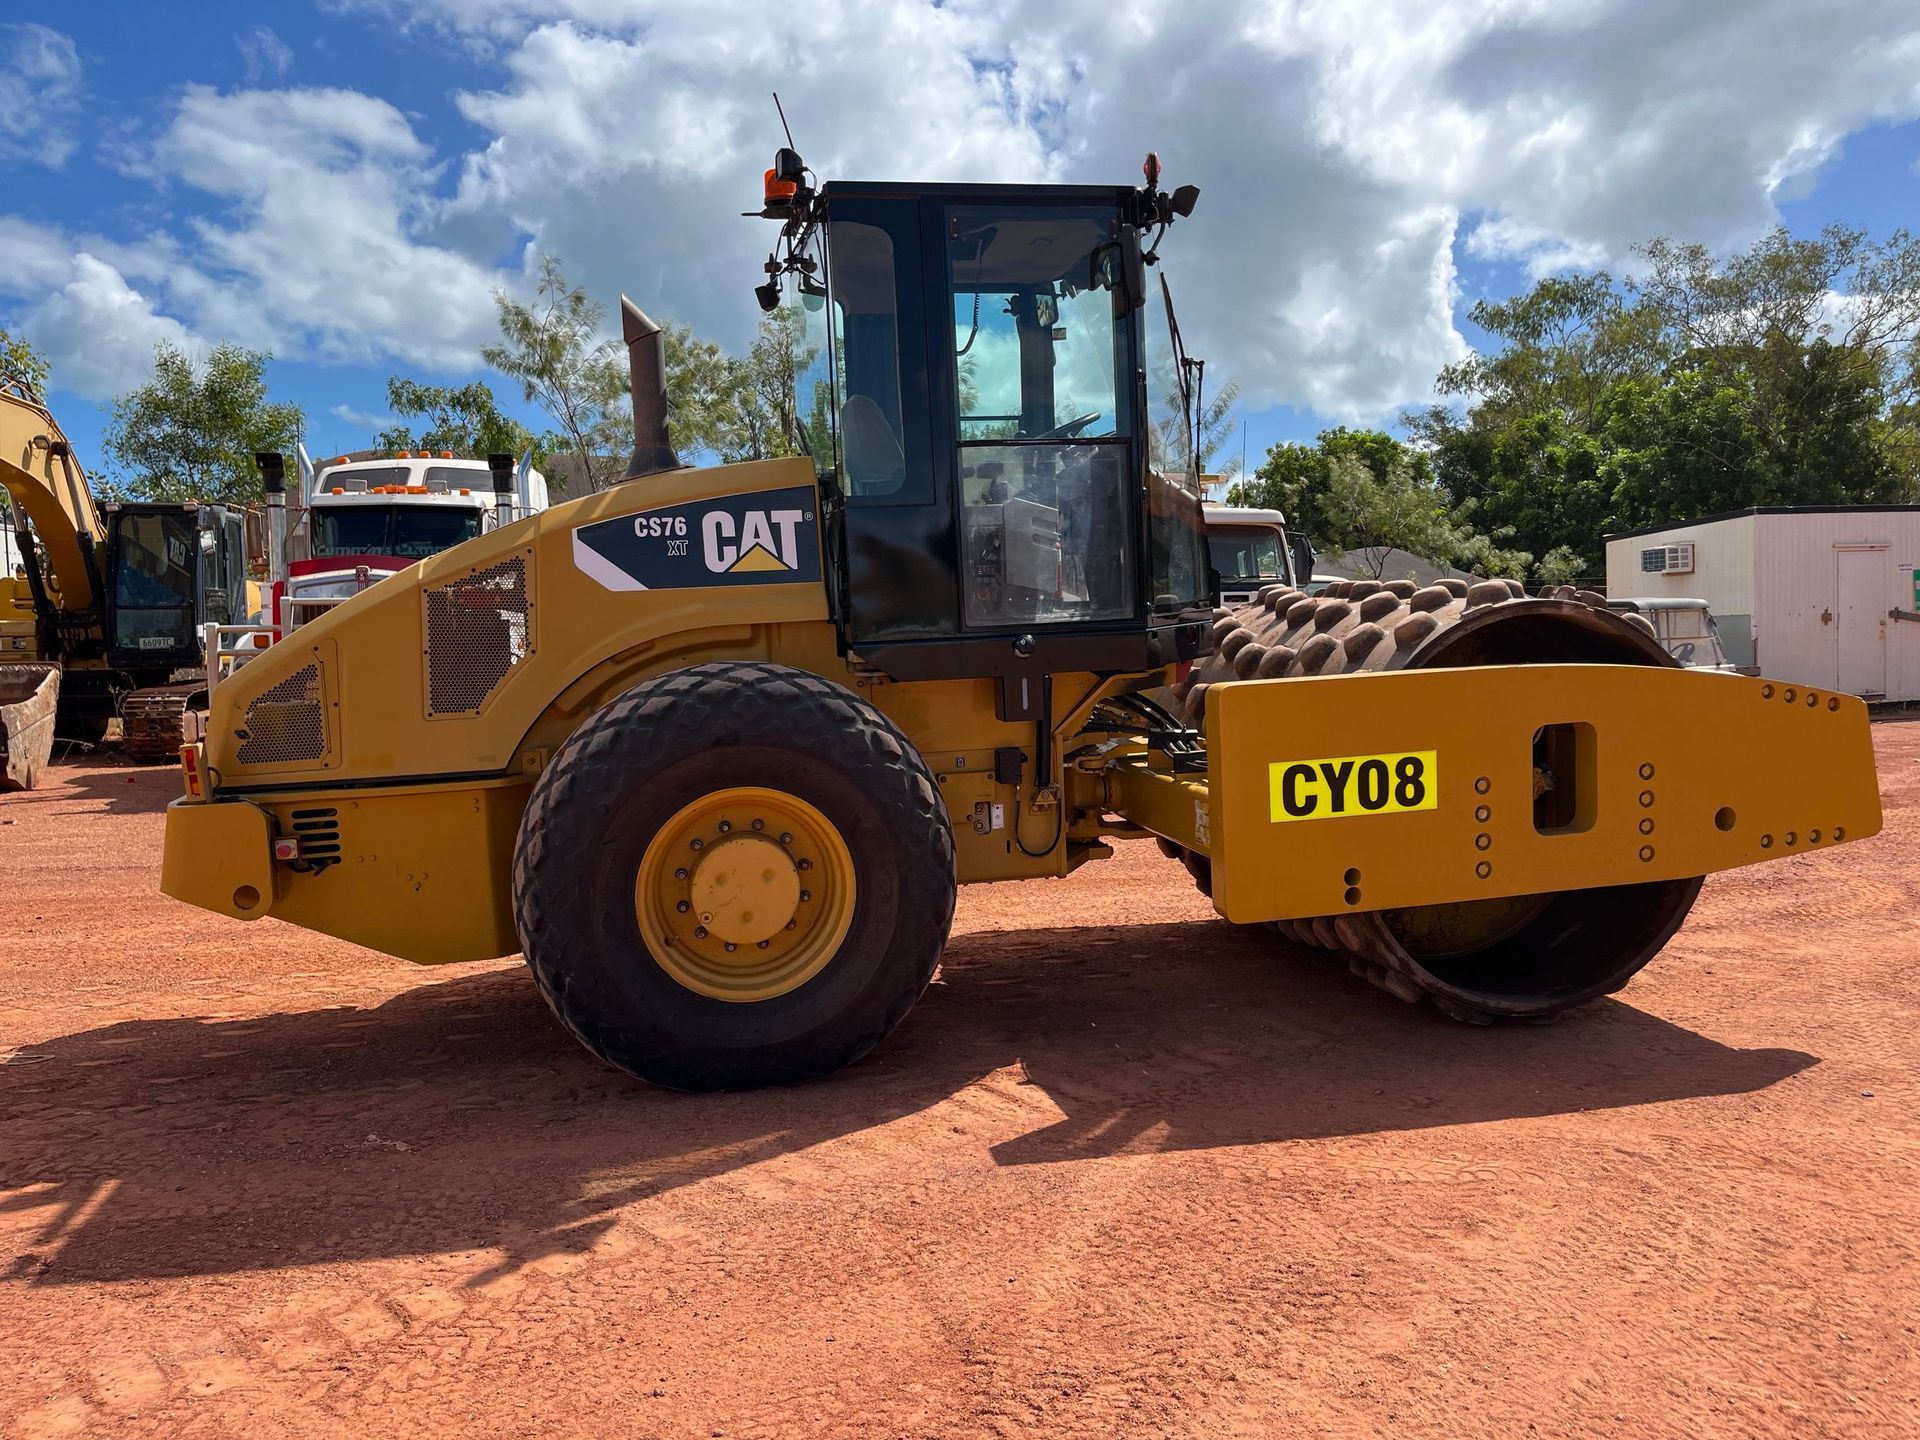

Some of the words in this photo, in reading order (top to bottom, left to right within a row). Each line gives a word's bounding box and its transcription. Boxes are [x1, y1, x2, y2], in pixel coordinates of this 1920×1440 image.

[634, 516, 687, 538] CS76
[316, 545, 392, 556] Cummins
[667, 540, 689, 556] XT
[1282, 756, 1426, 817] CY08
